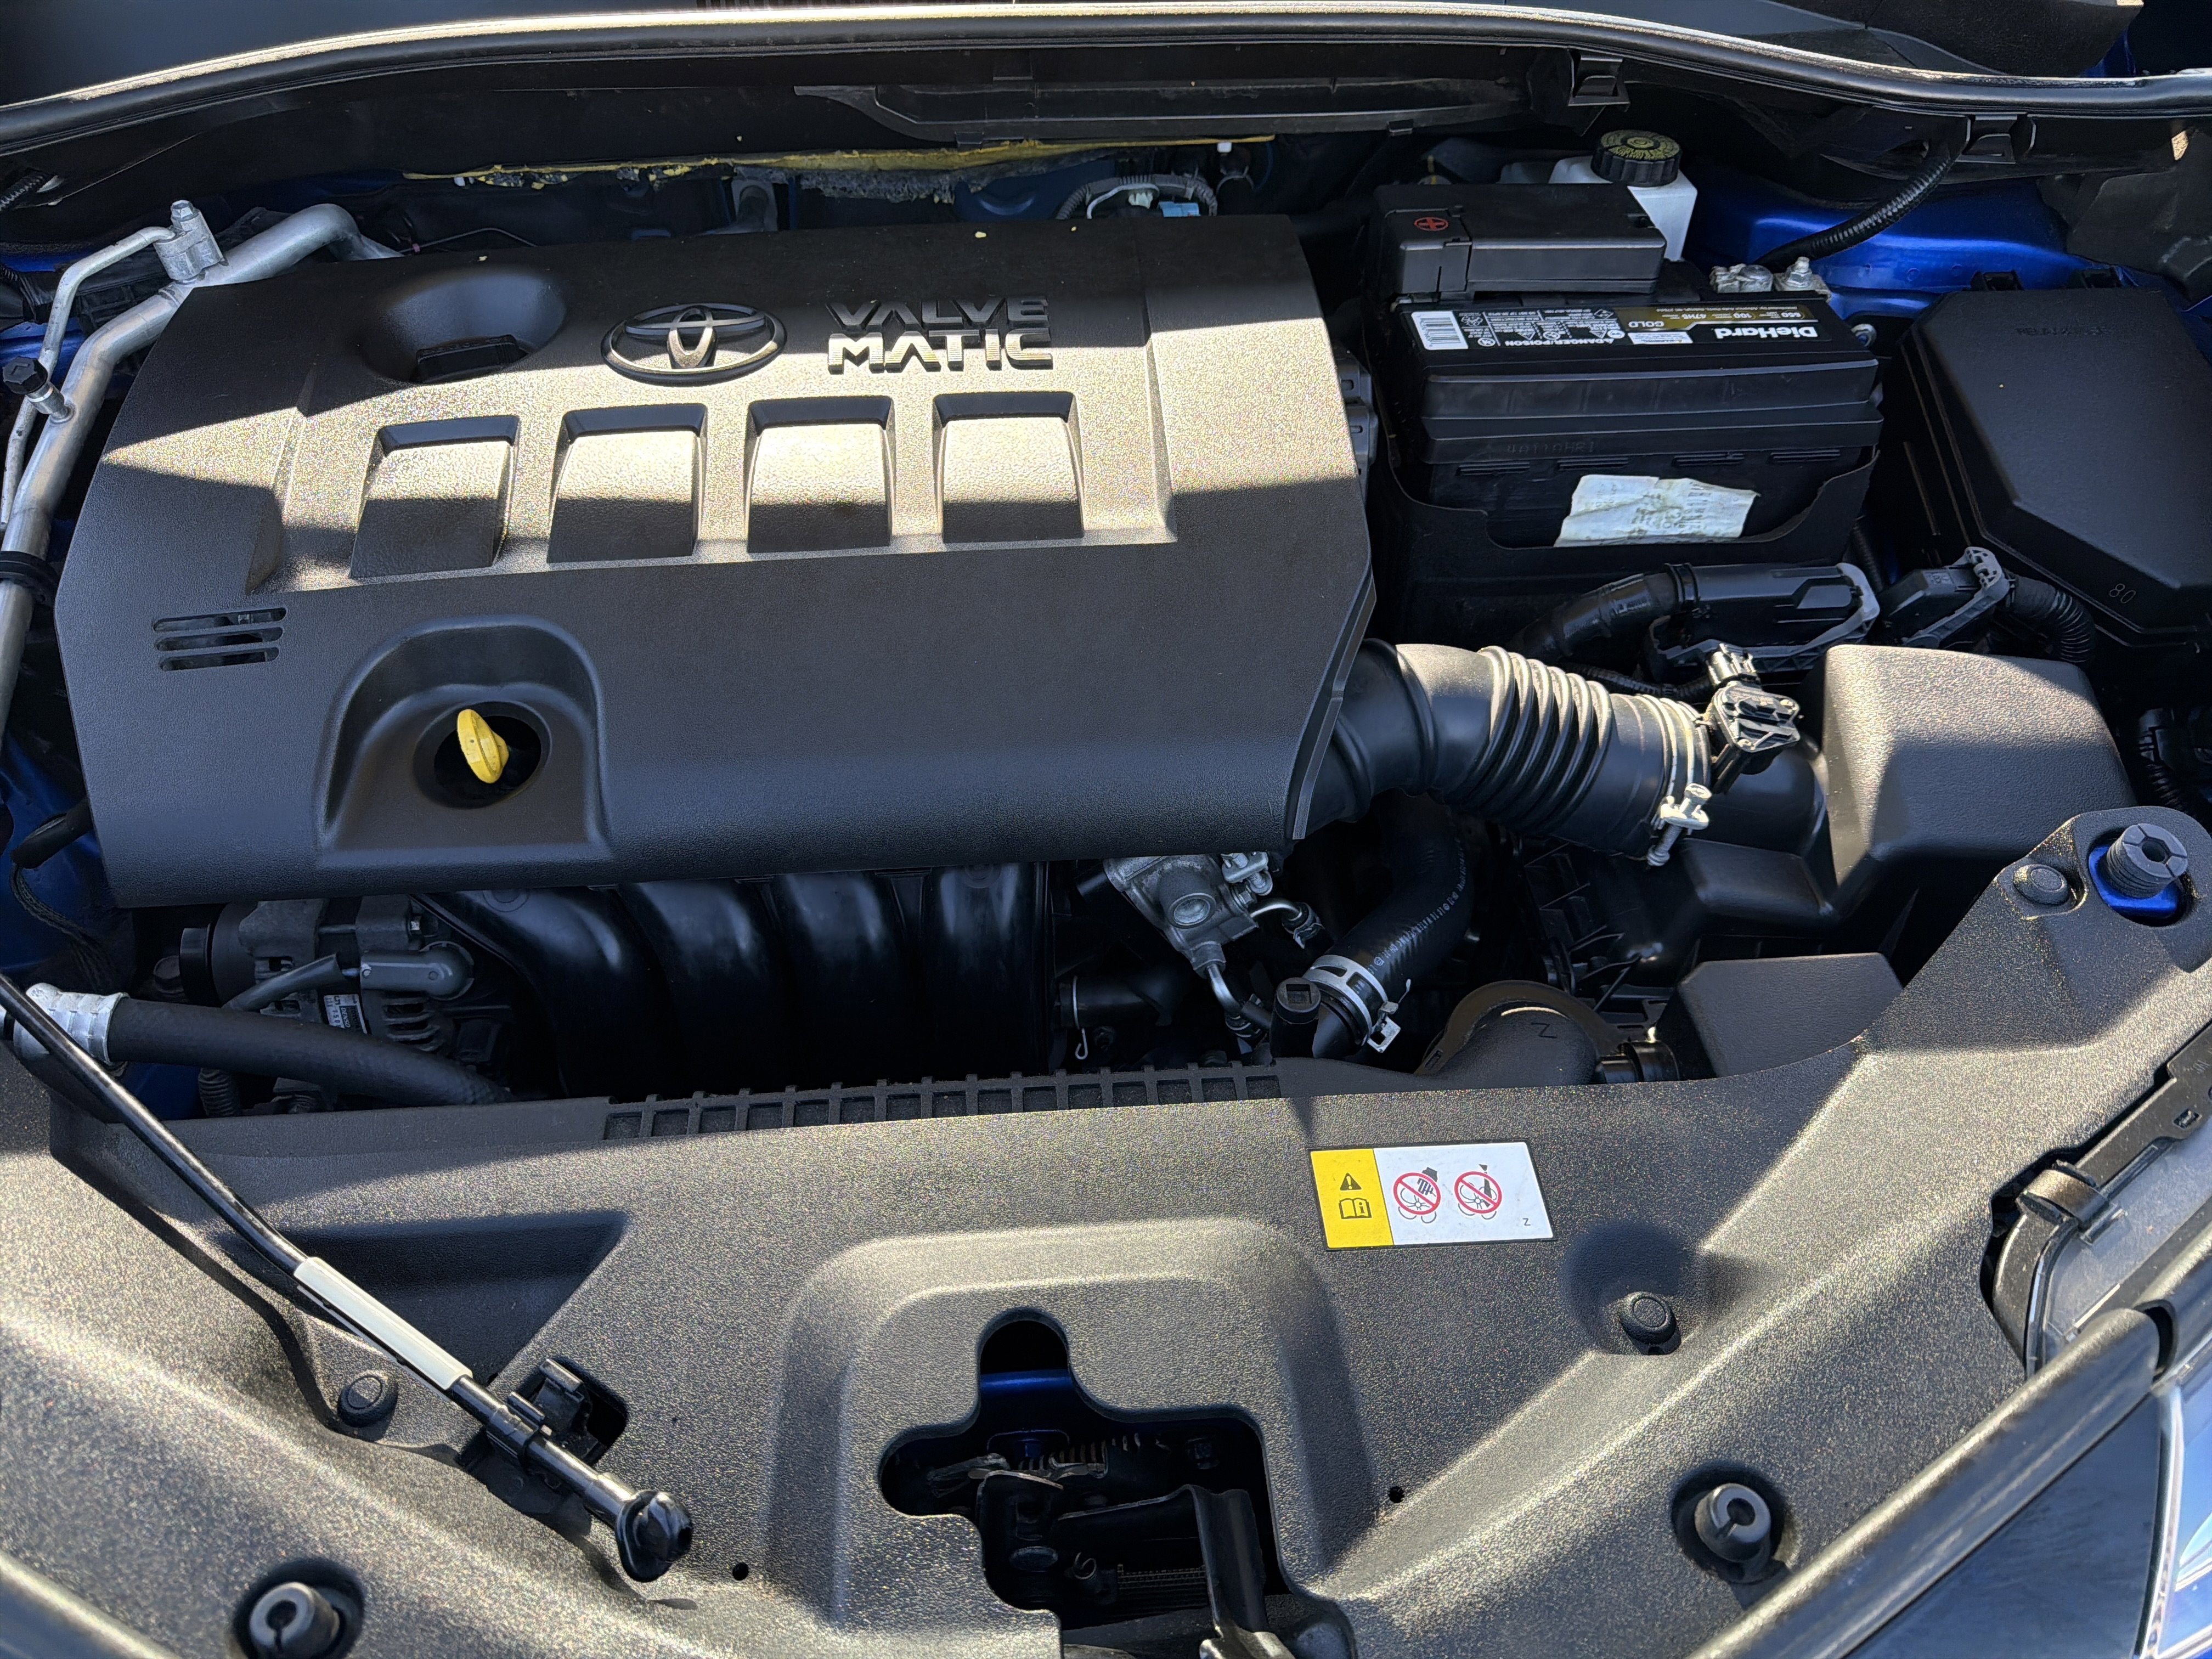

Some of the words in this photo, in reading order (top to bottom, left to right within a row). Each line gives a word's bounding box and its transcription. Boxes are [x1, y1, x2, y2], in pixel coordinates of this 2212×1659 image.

[826, 296, 1050, 330] VALVE
[1714, 326, 1819, 339] DieHard
[827, 330, 1053, 374] MATIC
[2108, 583, 2136, 604] 80
[341, 1007, 351, 1028] DENSO
